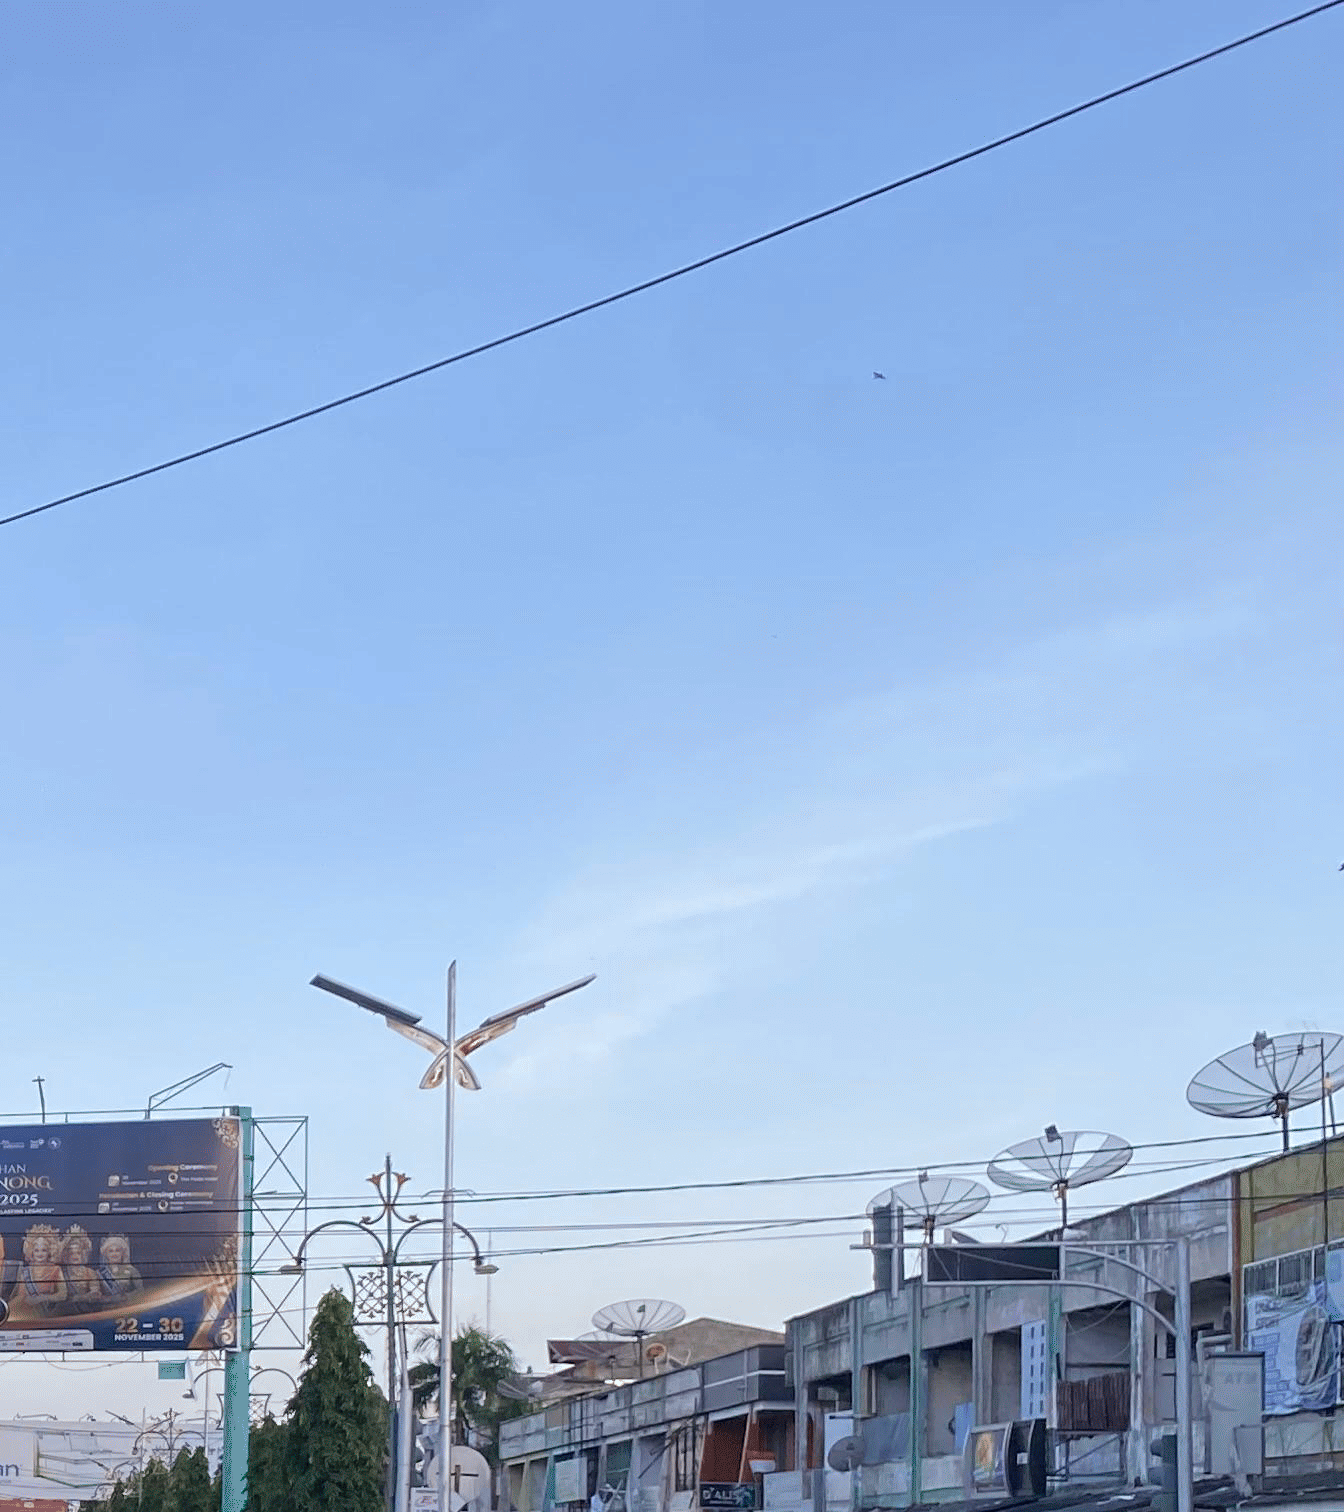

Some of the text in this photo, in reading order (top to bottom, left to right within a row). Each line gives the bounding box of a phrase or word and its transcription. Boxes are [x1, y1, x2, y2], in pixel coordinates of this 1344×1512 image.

[0, 1193, 39, 1207] 2025
[115, 1317, 139, 1333] 22
[158, 1317, 184, 1333] 30
[114, 1333, 184, 1341] NOVEMBER 2025
